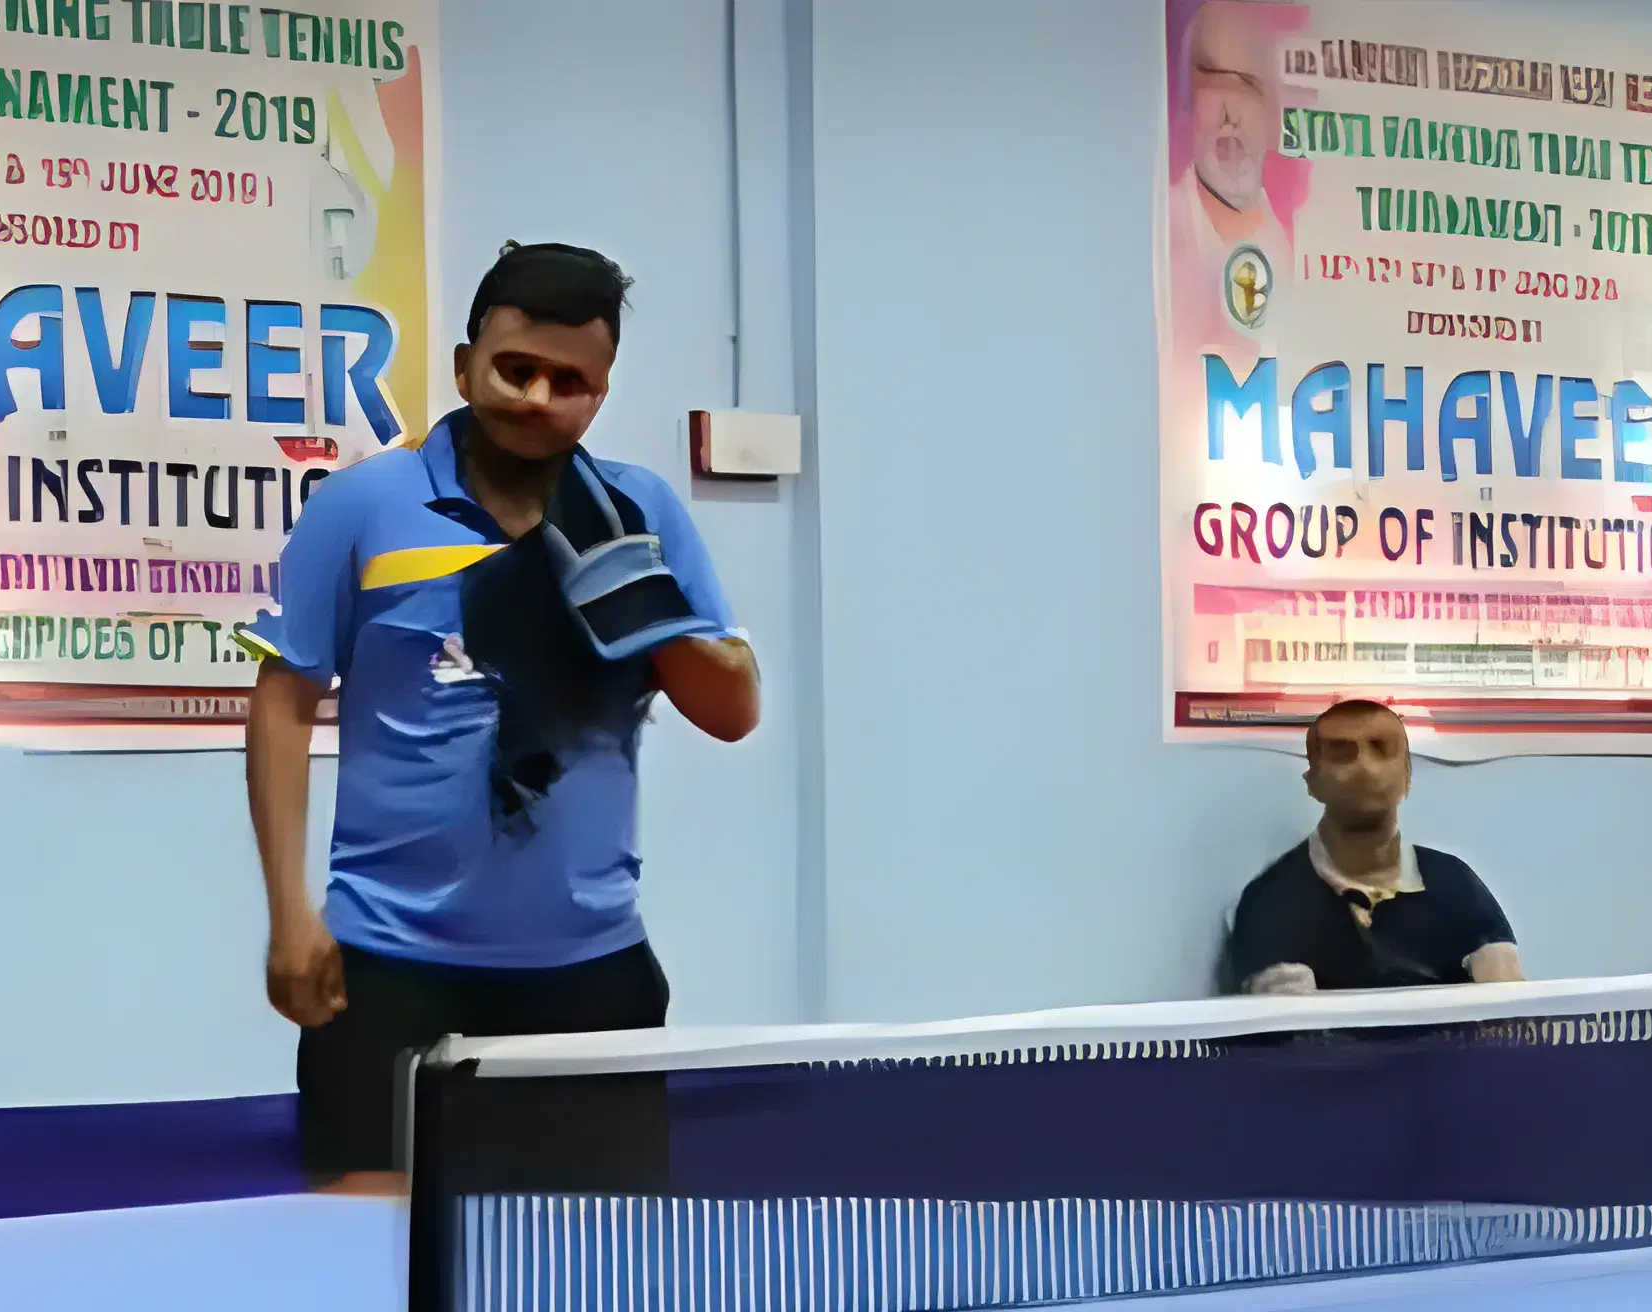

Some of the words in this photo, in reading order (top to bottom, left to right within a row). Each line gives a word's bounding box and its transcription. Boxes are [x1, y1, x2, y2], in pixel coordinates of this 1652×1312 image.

[215, 88, 316, 144] 2019
[1194, 502, 1360, 563] GROUP
[1379, 506, 1435, 565] OF
